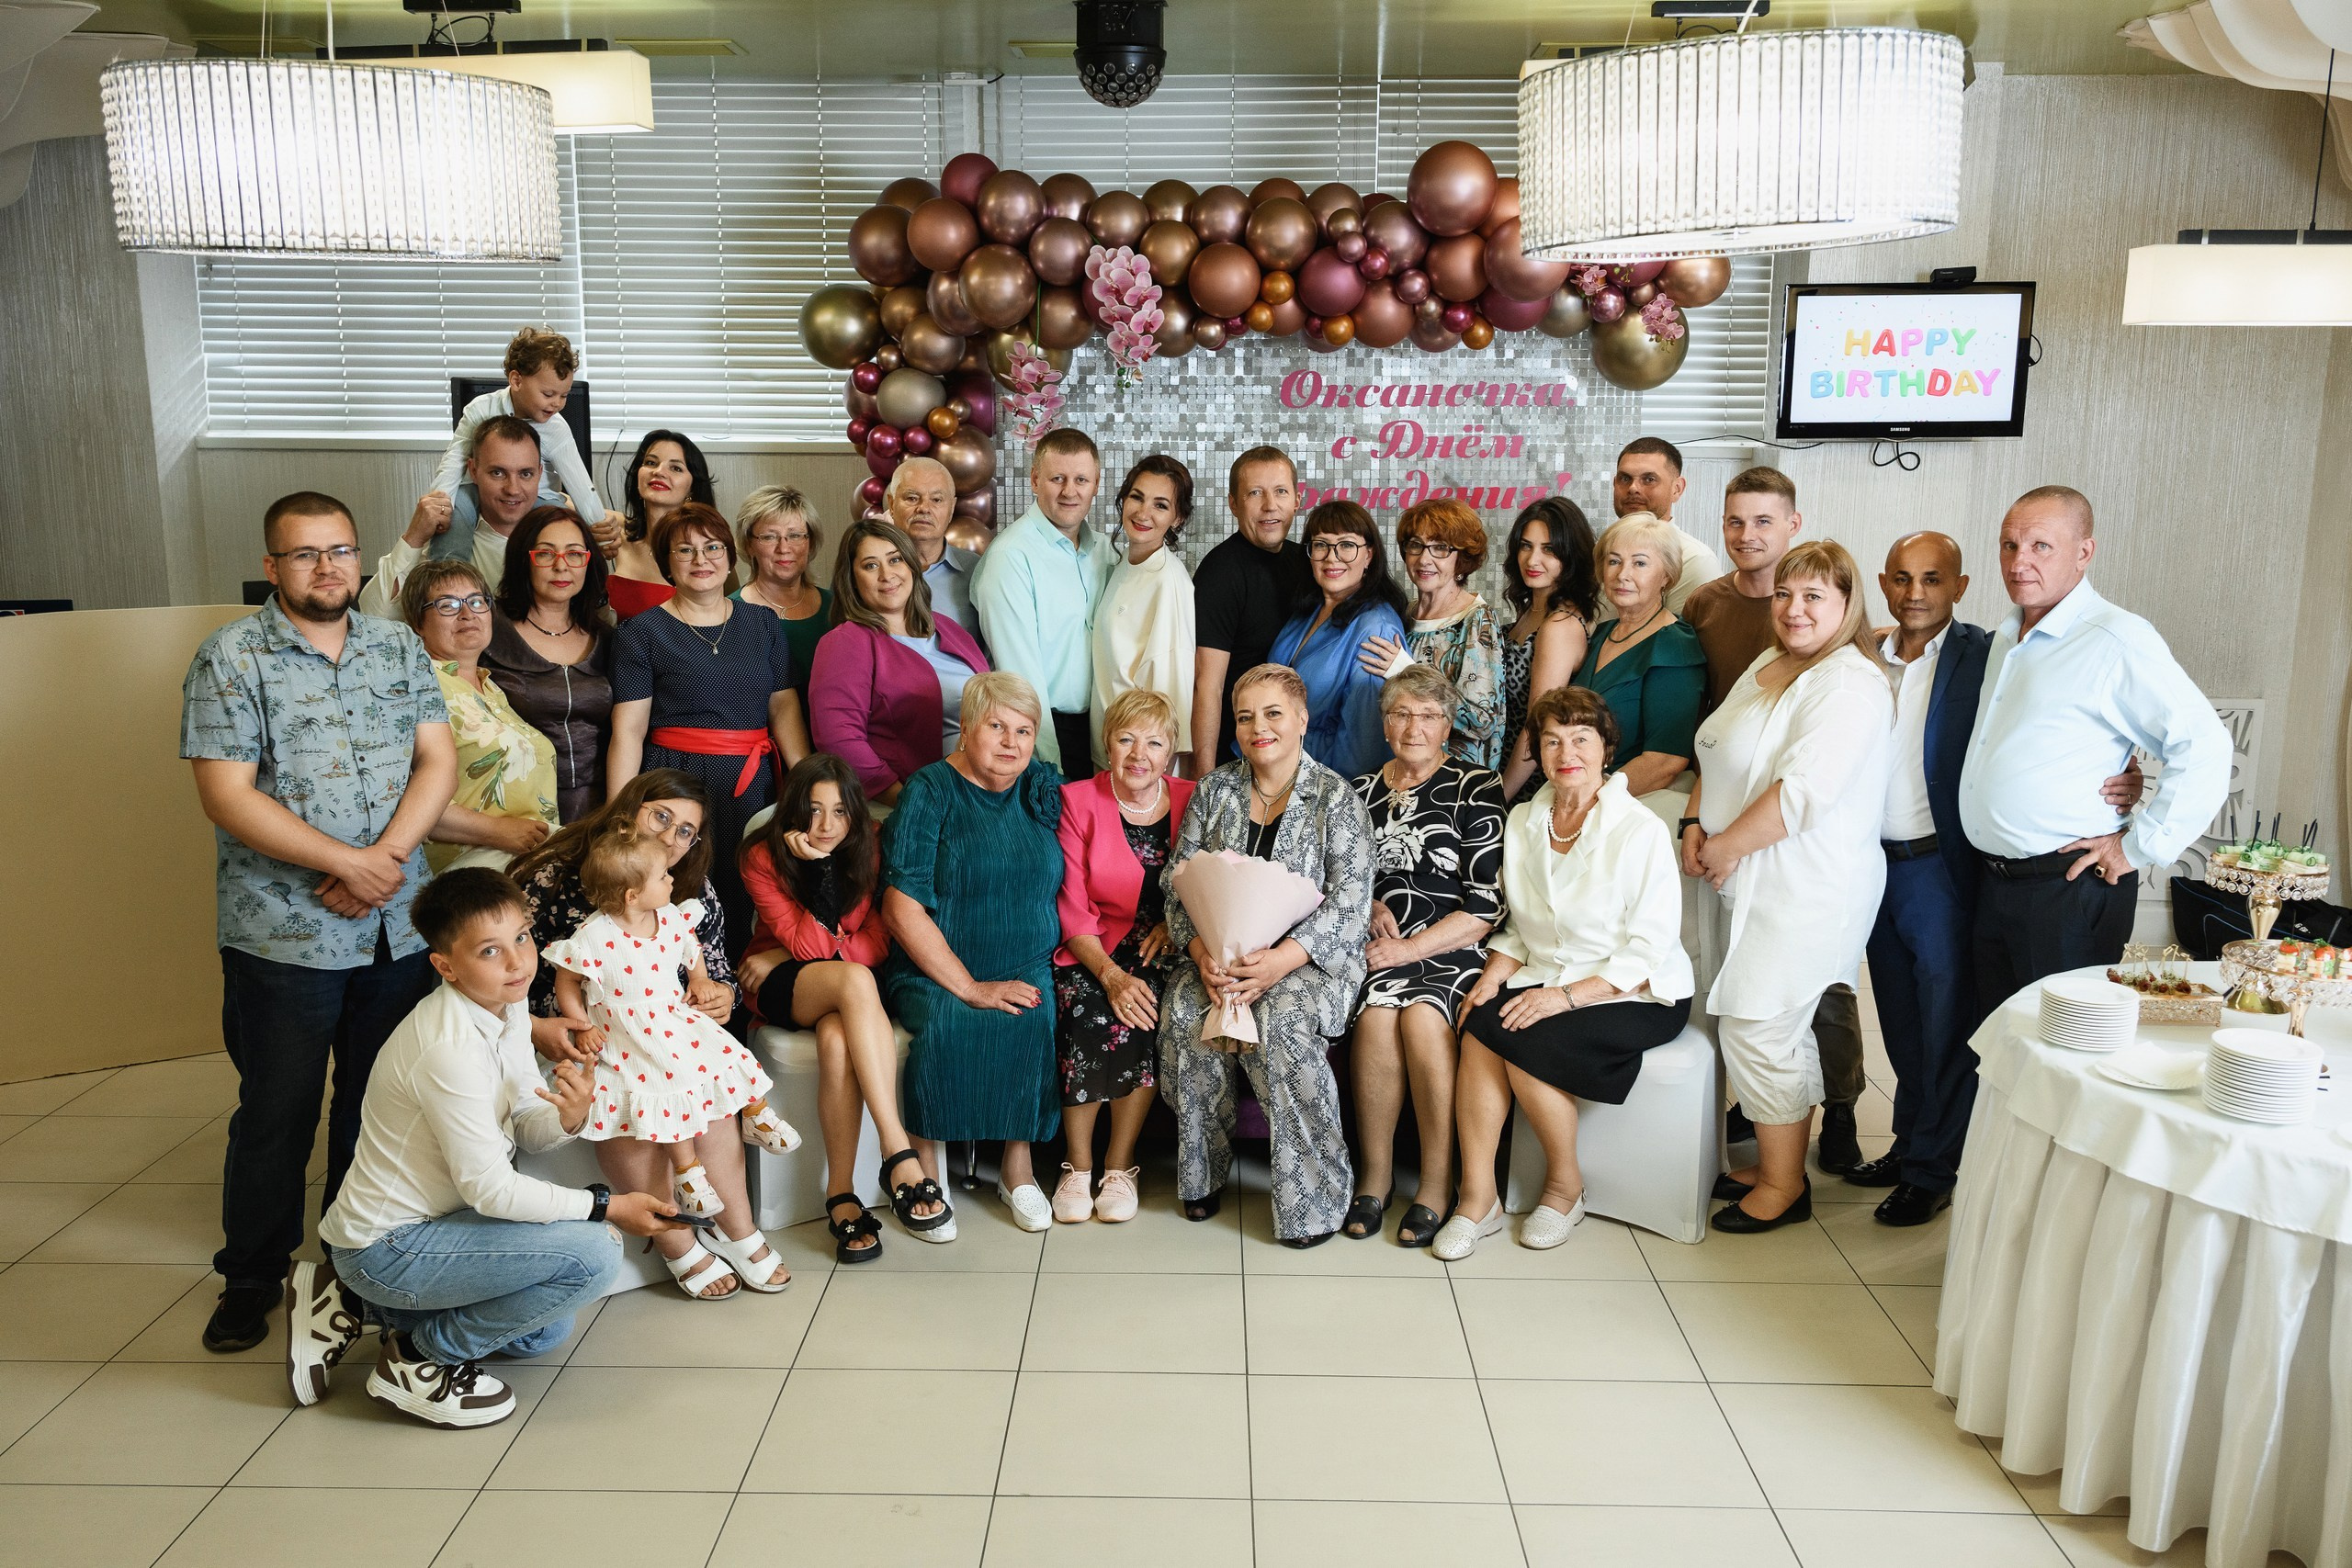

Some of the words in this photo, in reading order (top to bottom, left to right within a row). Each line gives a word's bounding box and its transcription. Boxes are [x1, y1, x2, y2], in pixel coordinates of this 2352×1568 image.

[1844, 328, 1976, 357] HAPPY
[1810, 367, 2001, 399] BIRTHDAY
[1330, 435, 1358, 459] с
[1370, 420, 1525, 459] Днём
